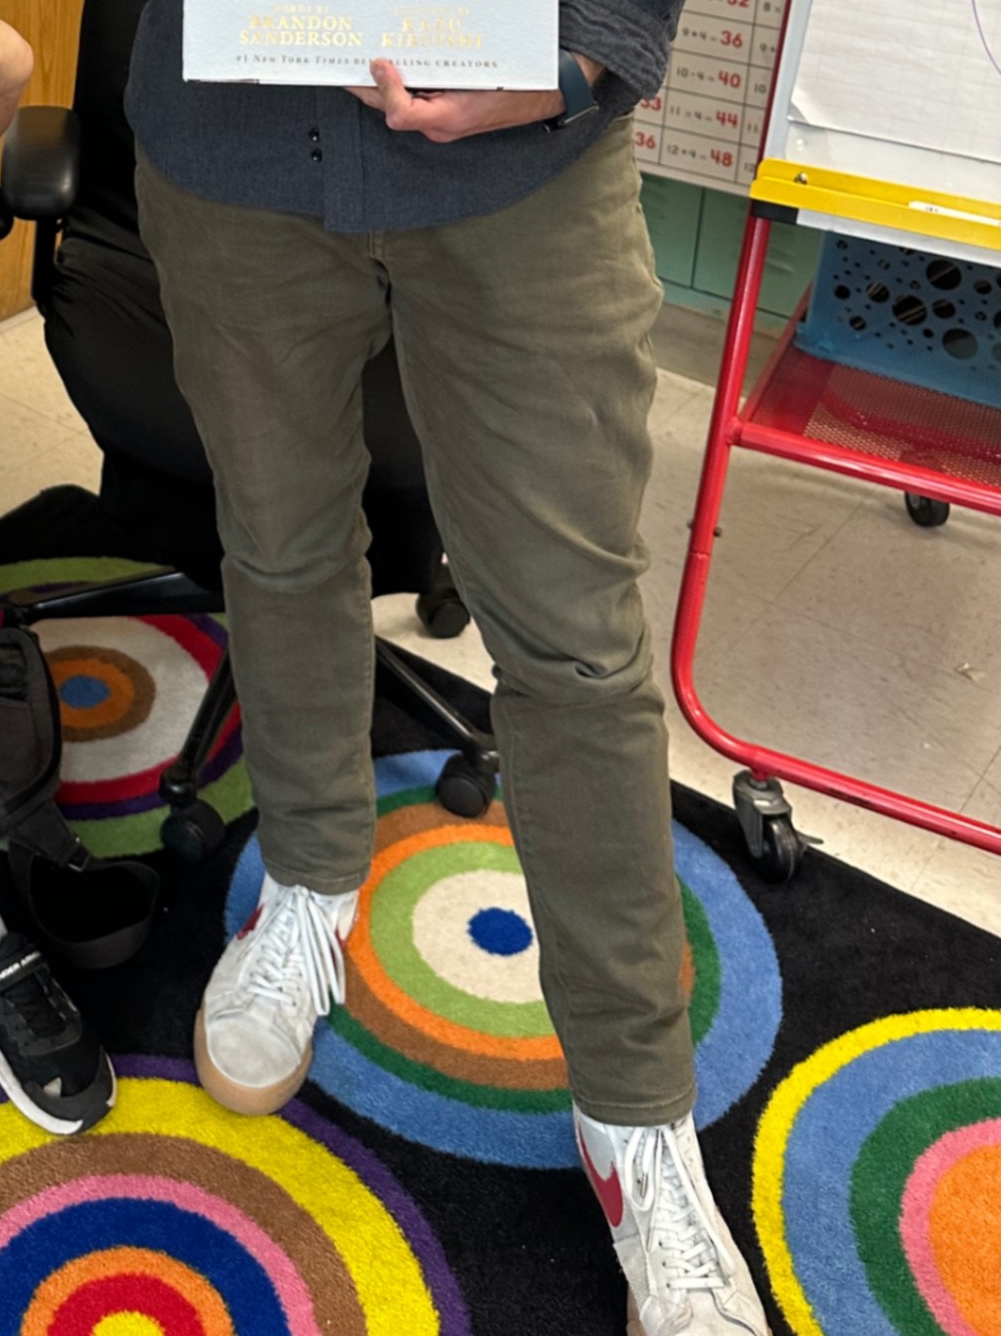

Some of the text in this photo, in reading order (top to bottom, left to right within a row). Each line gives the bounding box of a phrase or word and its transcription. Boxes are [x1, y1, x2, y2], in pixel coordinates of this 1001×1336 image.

[249, 15, 353, 31] BRANDON
[239, 31, 363, 47] SANDERSON
[720, 30, 743, 49] 36
[718, 69, 741, 89] 40
[715, 109, 738, 129] 44
[635, 131, 656, 151] 36
[710, 148, 734, 168] 48
